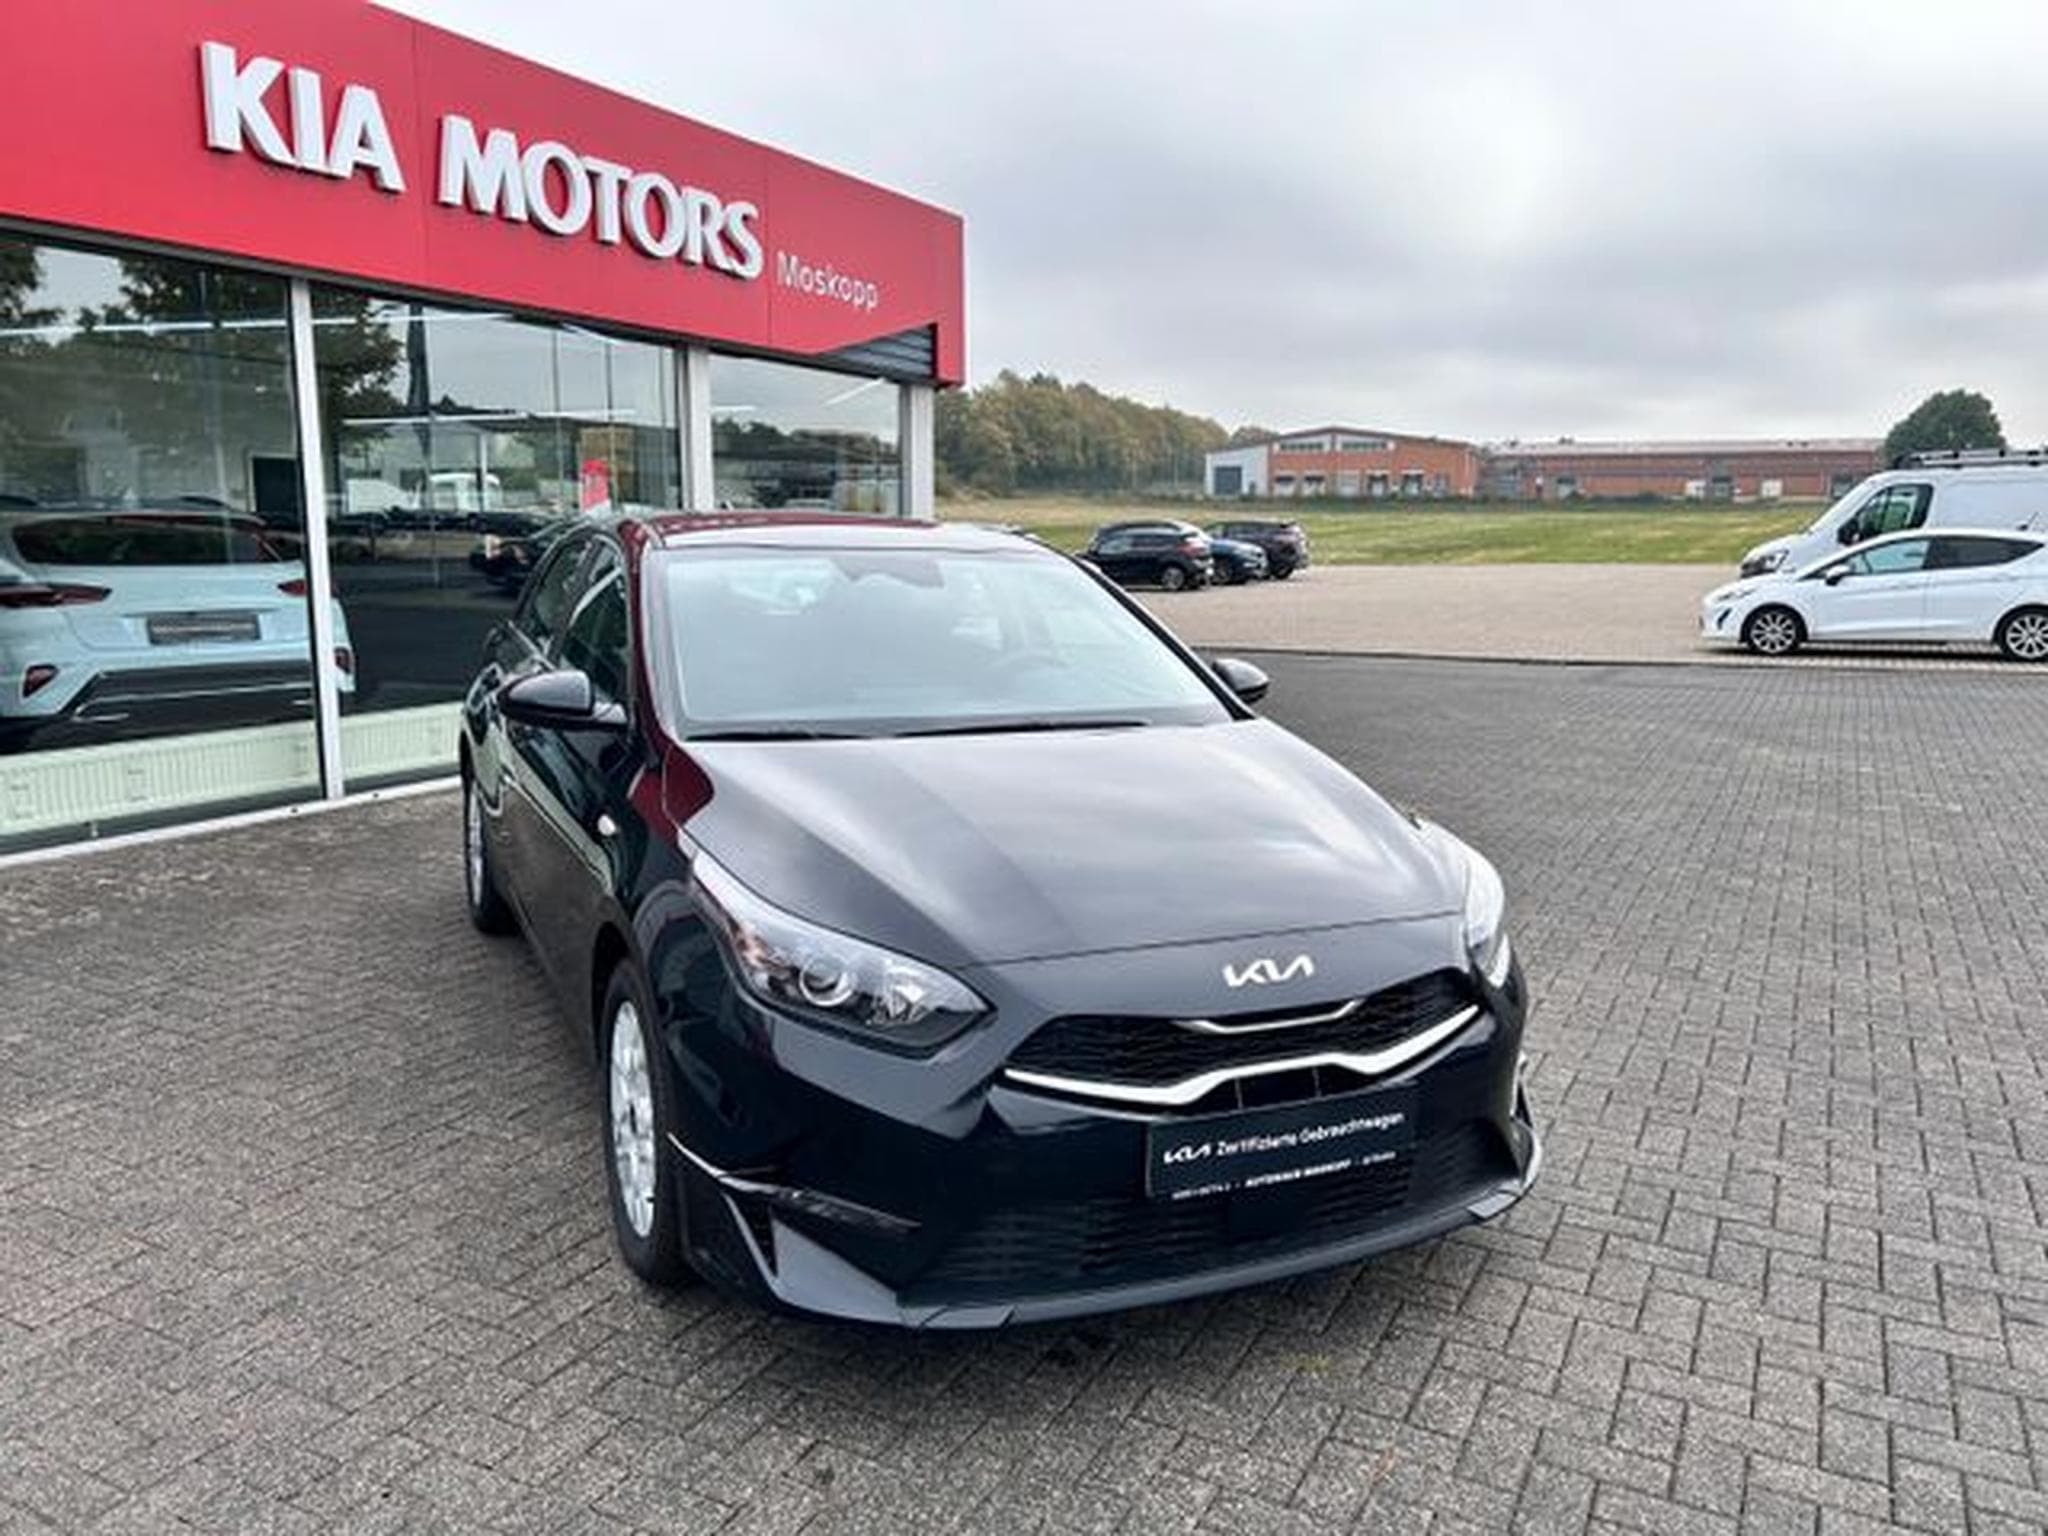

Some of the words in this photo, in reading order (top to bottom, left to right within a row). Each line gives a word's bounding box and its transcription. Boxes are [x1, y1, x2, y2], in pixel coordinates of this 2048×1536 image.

[200, 40, 406, 194] KIA
[438, 114, 764, 280] MOTORS
[776, 249, 880, 313] Moskopp
